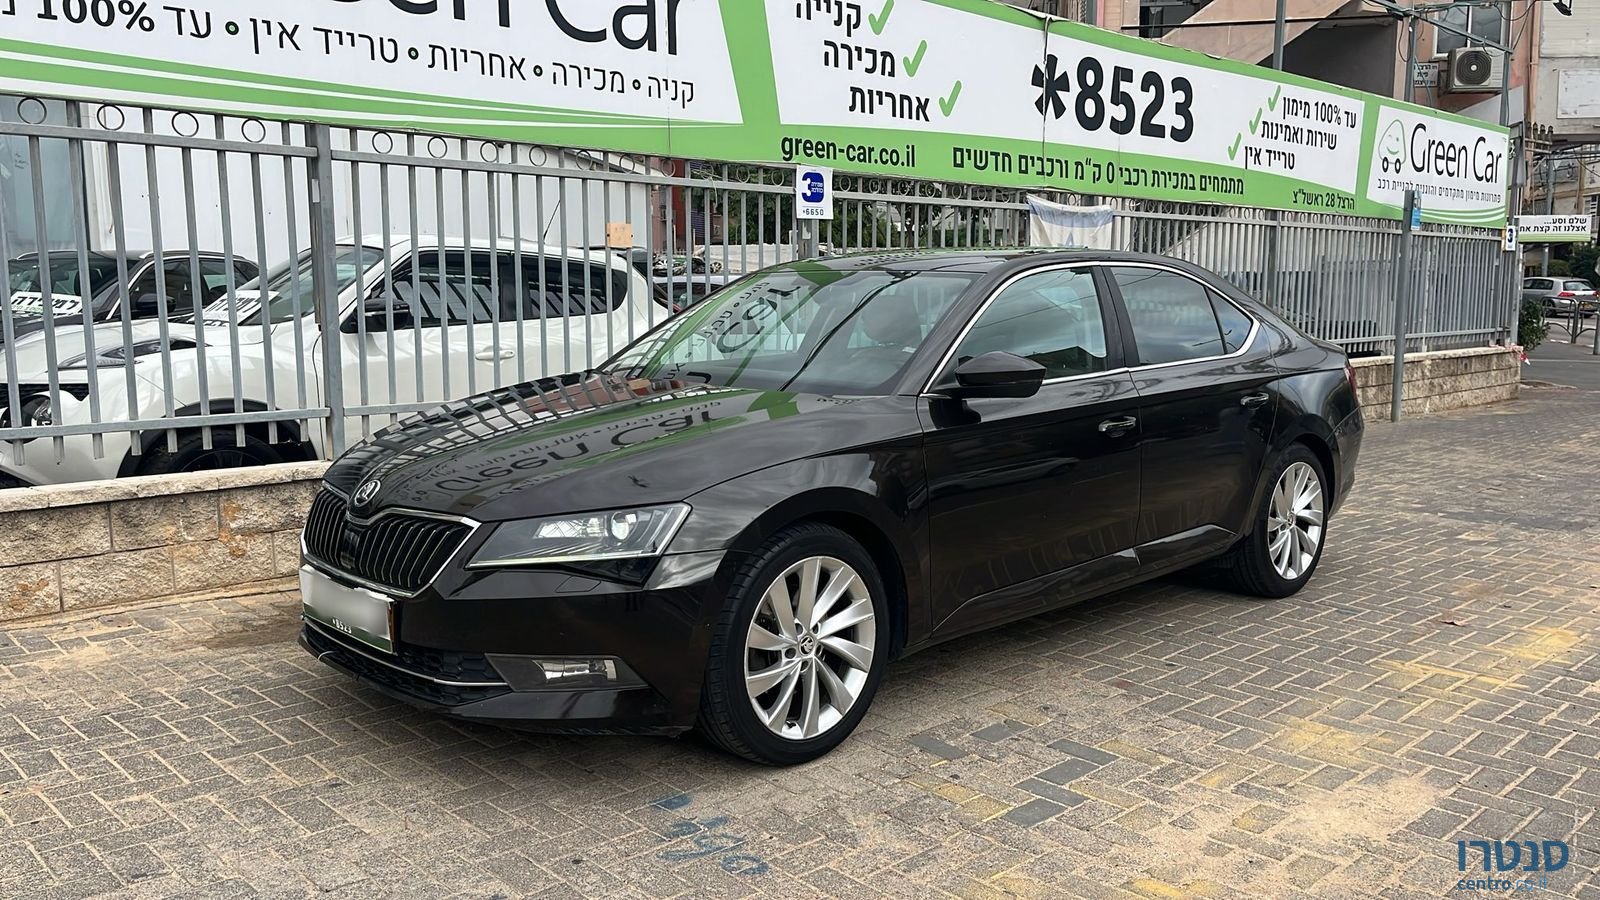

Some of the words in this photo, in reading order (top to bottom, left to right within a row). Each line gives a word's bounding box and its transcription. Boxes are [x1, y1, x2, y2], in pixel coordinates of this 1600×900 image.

[162, 5, 212, 39] עד
[796, 0, 861, 37] קנייה
[249, 17, 301, 55] אין
[313, 26, 399, 64] טרייד
[427, 43, 528, 81] אחריות
[823, 39, 896, 78] מכירה
[552, 61, 625, 94] מכירה
[647, 75, 695, 109] קניה
[848, 85, 930, 122] אחריות
[1282, 96, 1311, 120] מימון
[1314, 100, 1342, 126] 100%
[1344, 110, 1357, 129] עד
[1261, 120, 1303, 145] ואמינות
[1306, 128, 1337, 150] שירות
[781, 136, 916, 168] green-car.co.il
[952, 146, 1012, 173] חדשים
[1244, 145, 1262, 170] אין
[1265, 148, 1295, 170] טרייד
[1410, 122, 1468, 180] Green
[1473, 136, 1502, 184] Car
[1018, 154, 1069, 179] ורכבים
[1119, 166, 1147, 187] רכבי
[1151, 168, 1197, 191] במכירת
[1200, 174, 1244, 195] מתמחים
[1325, 192, 1335, 208] 28
[1337, 194, 1354, 210] הרצל
[1533, 226, 1551, 234] קצת
